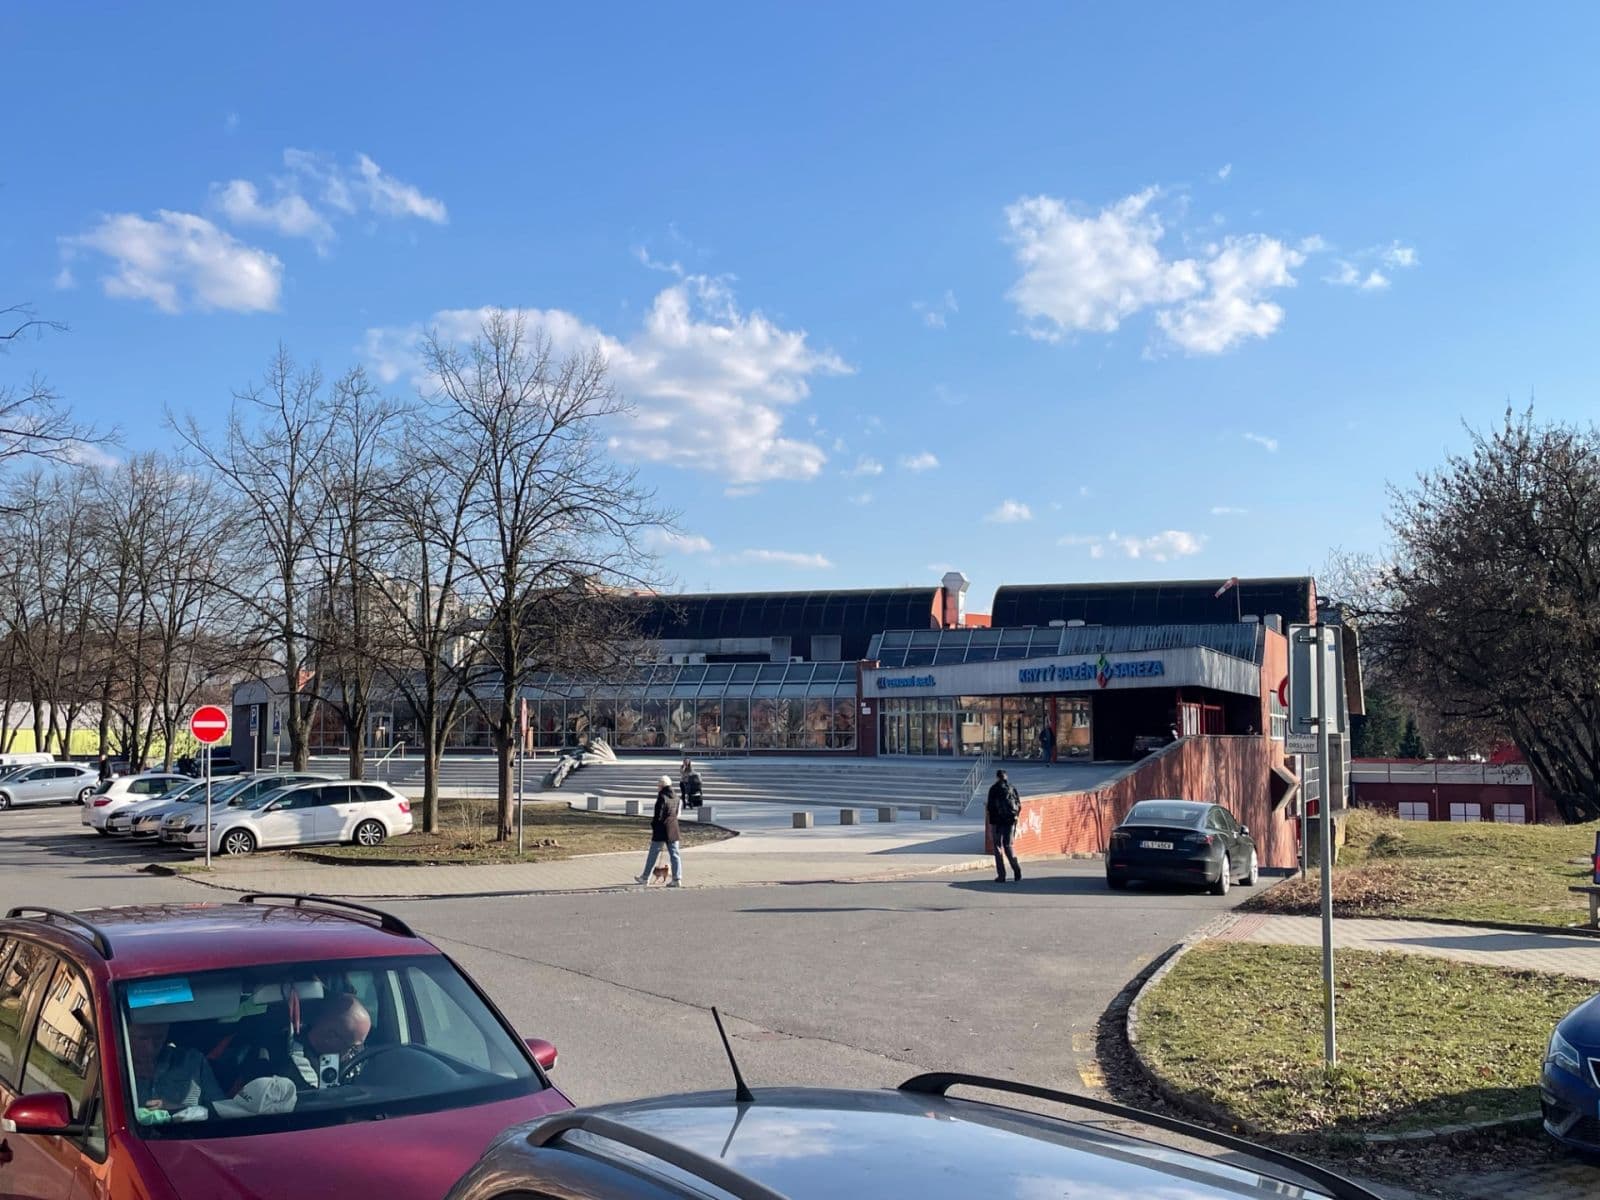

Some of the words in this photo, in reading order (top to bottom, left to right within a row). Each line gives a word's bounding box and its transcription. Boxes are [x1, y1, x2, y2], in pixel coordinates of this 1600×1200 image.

[1019, 665, 1055, 683] KRYTÝ
[1056, 661, 1097, 681] BAZÉN
[1112, 661, 1164, 678] SAREZA
